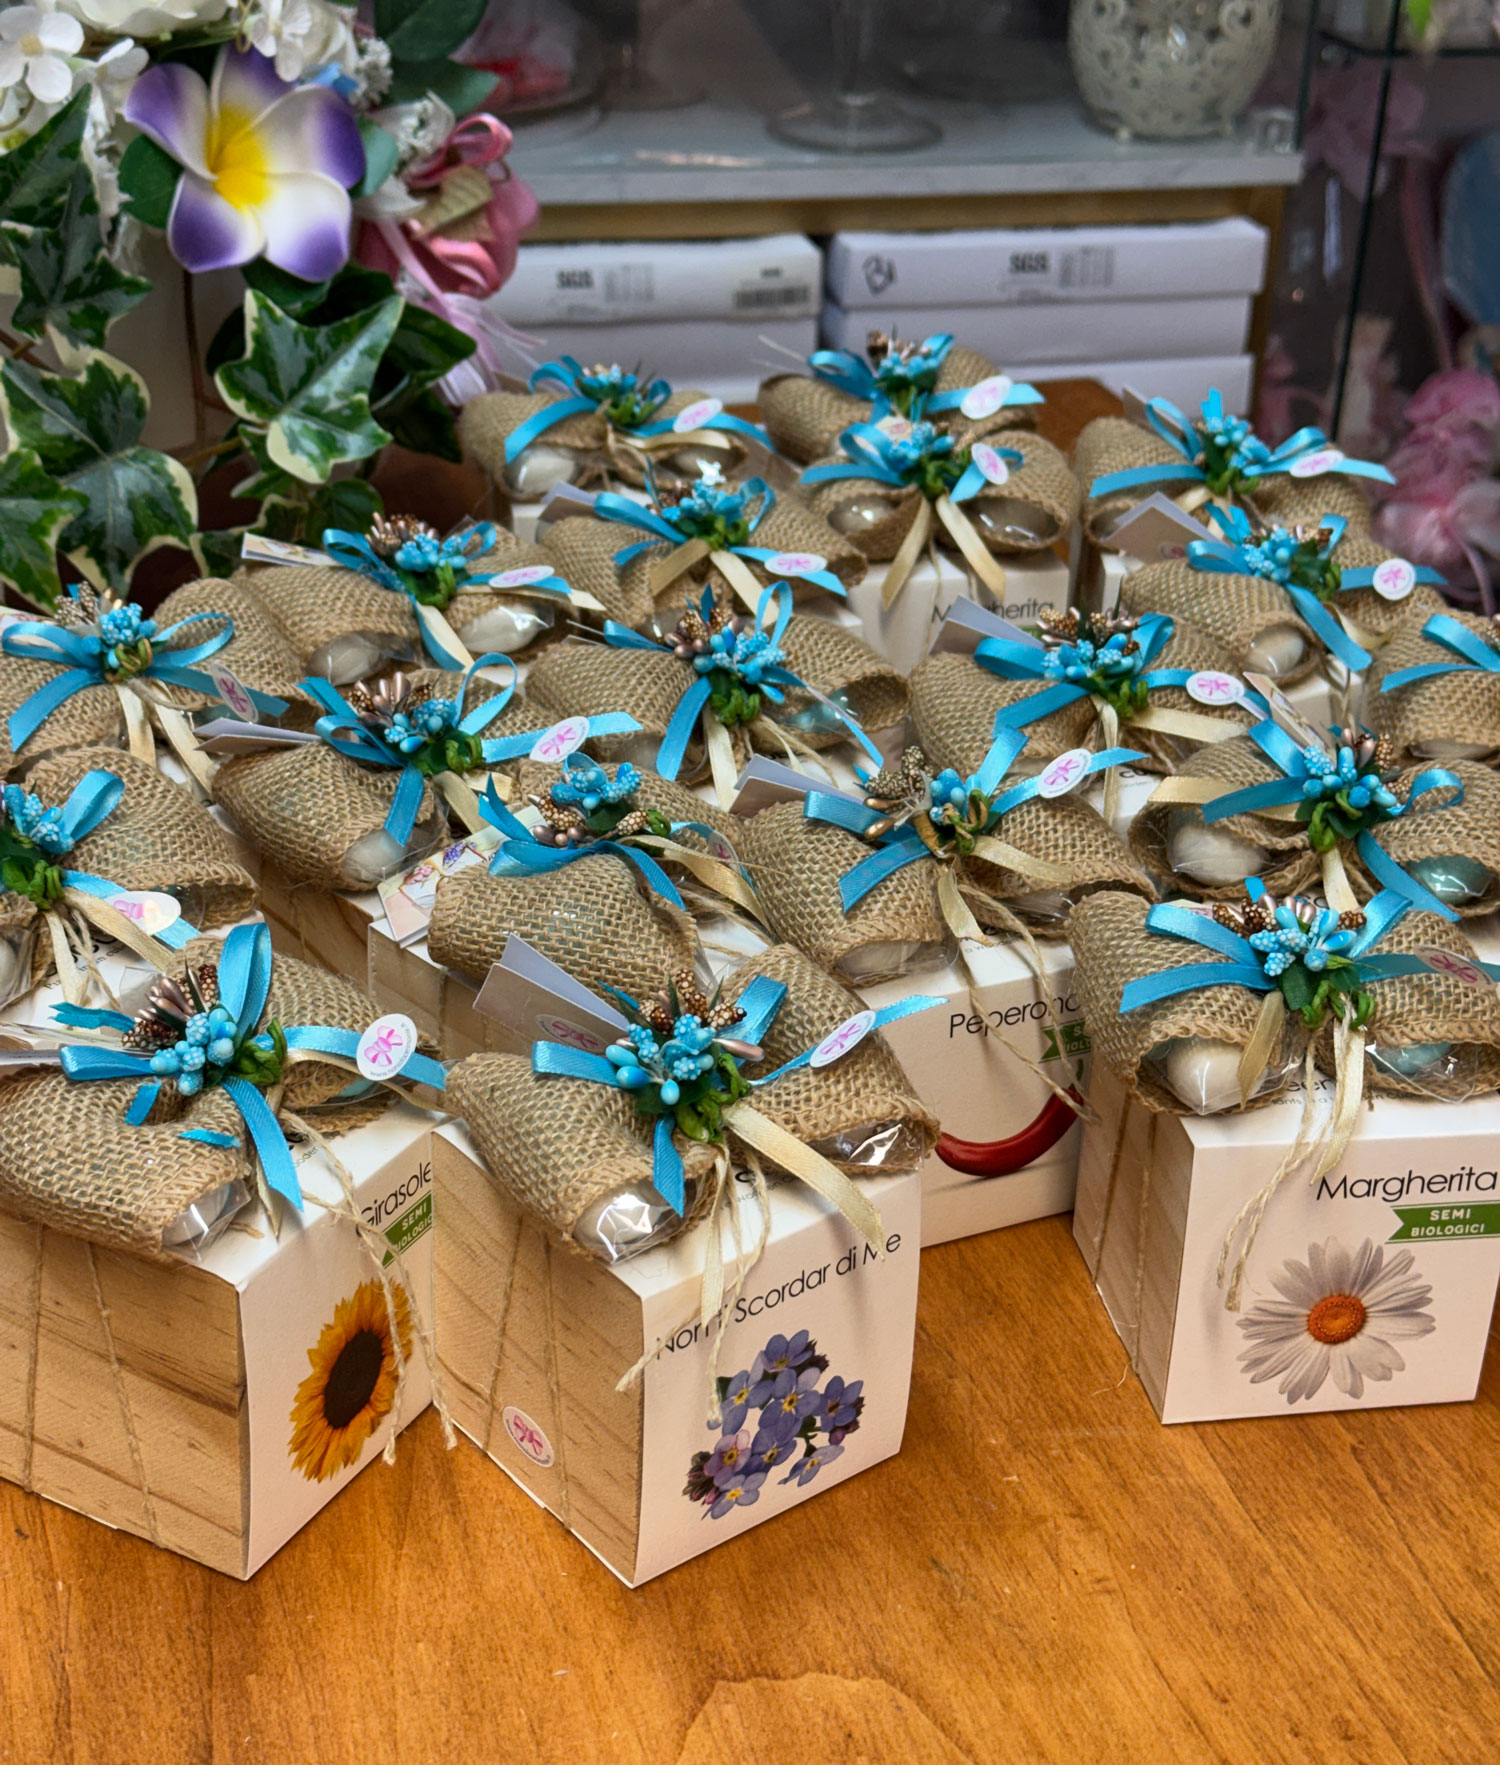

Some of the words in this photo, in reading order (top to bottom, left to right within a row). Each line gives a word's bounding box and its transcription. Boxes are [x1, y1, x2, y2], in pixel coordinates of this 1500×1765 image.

[1316, 1166, 1498, 1202] Margherita
[402, 1202, 427, 1231] SEMI
[1429, 1208, 1471, 1221] SEMI
[1410, 1223, 1485, 1237] BIOLOGICI
[733, 1263, 831, 1323] Scordar
[835, 1245, 857, 1277] di
